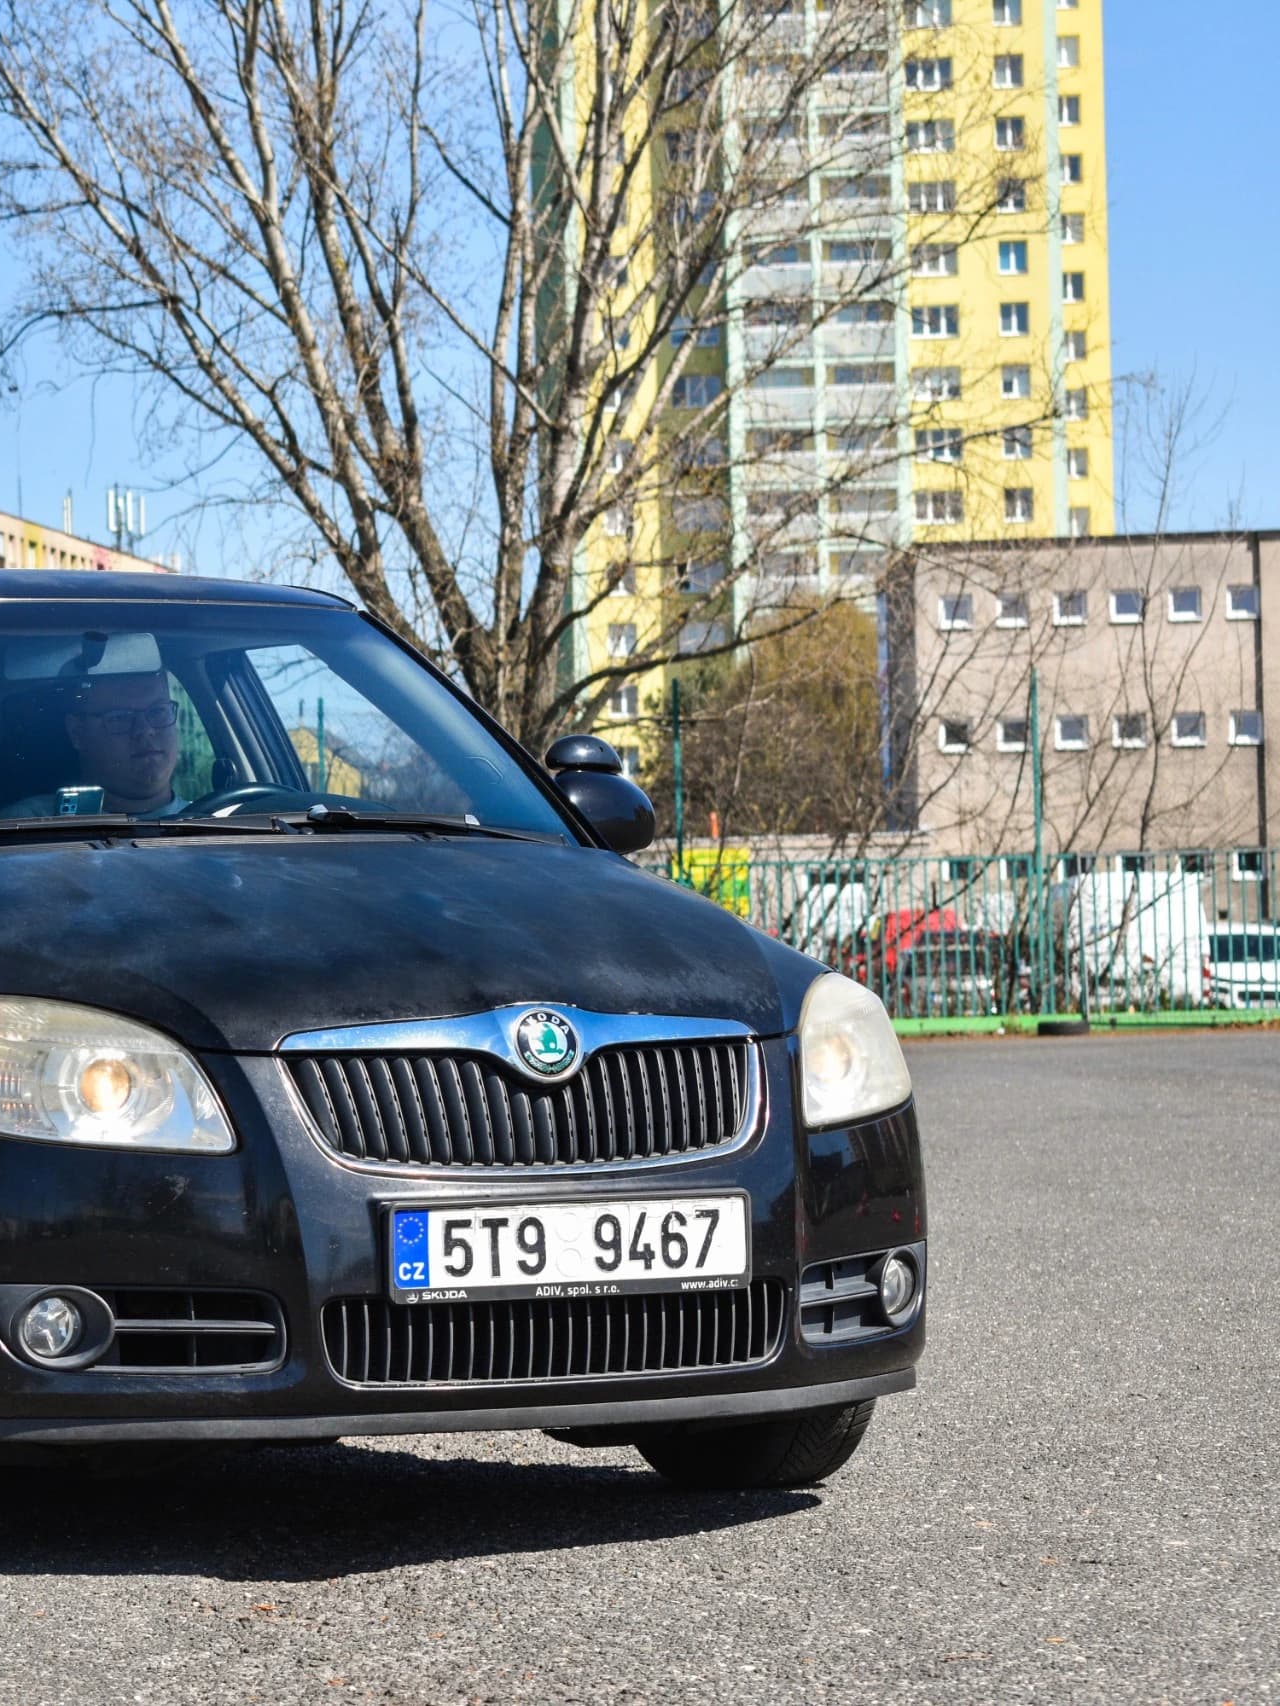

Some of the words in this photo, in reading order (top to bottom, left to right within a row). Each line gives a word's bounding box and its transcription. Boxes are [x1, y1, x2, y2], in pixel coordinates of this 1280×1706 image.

[443, 1216, 546, 1278] 5T9
[594, 1208, 720, 1272] 9467
[398, 1261, 425, 1281] CZ
[535, 1285, 565, 1297] ADIV,
[567, 1283, 592, 1297] spol.
[595, 1286, 601, 1294] s
[603, 1284, 620, 1294] r.o.
